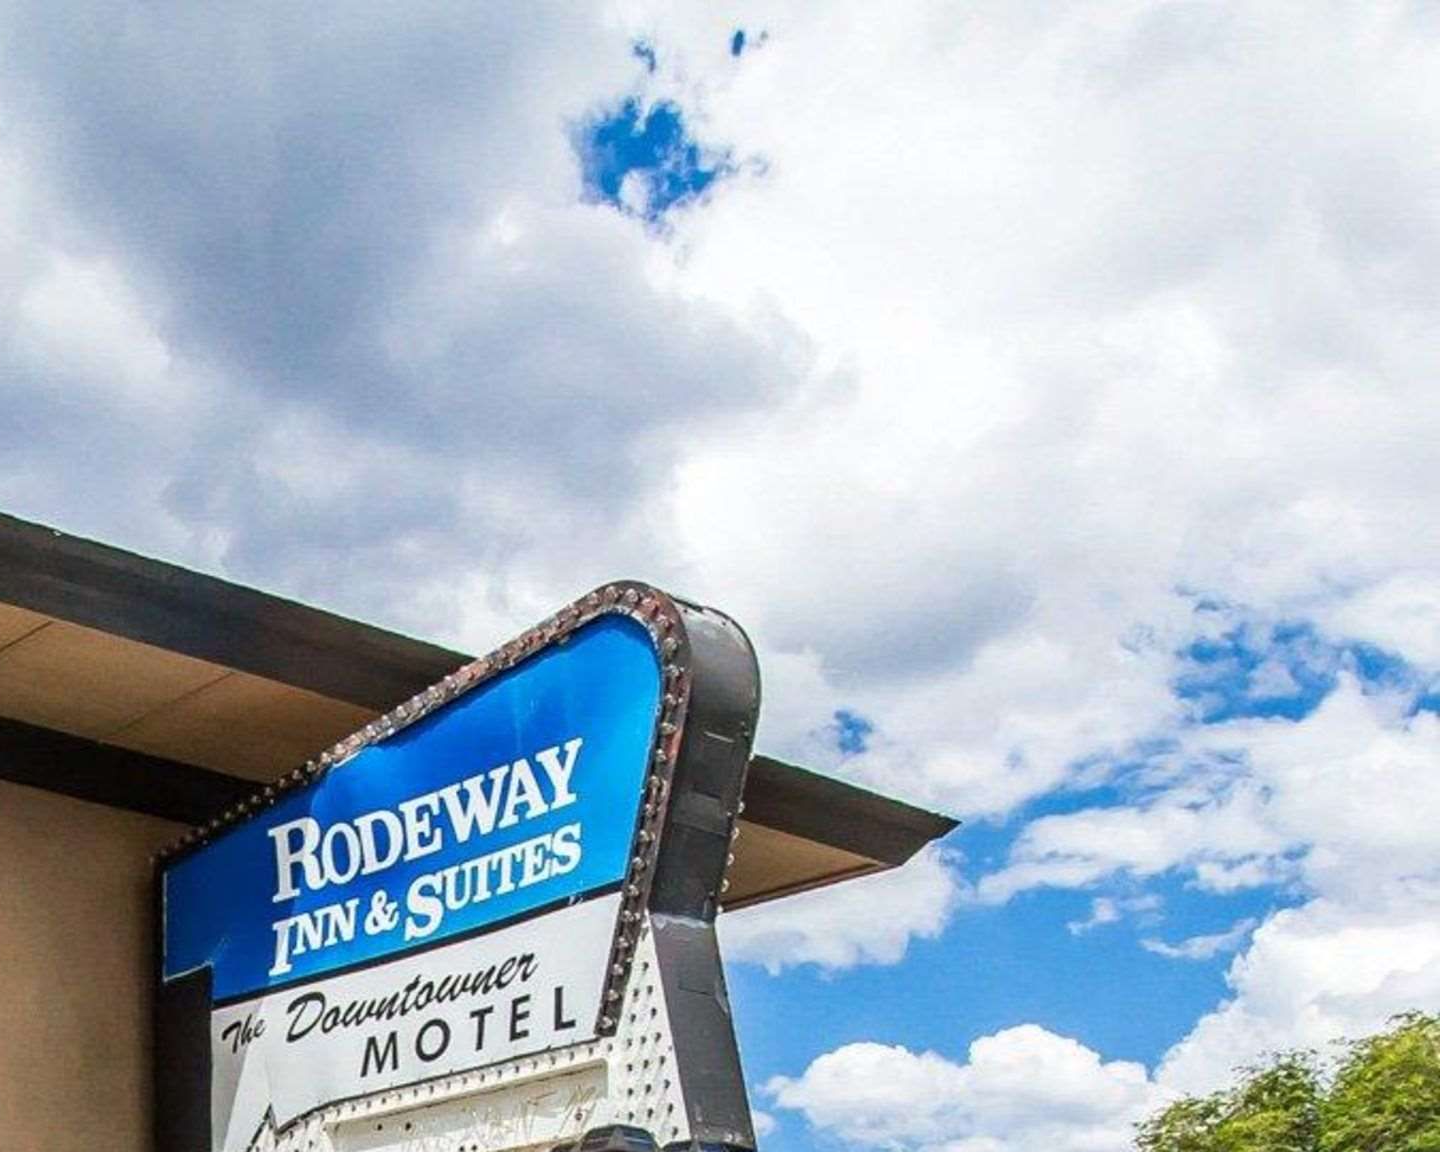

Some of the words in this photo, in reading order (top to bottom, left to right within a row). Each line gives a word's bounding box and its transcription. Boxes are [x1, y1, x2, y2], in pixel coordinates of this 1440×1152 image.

[267, 737, 583, 903] RODEWAY
[268, 898, 359, 976] INN
[364, 889, 400, 936] &
[404, 822, 582, 941] SUITES
[221, 1016, 266, 1054] The
[286, 951, 539, 1043] Downtowner
[360, 985, 576, 1078] MOTEL
